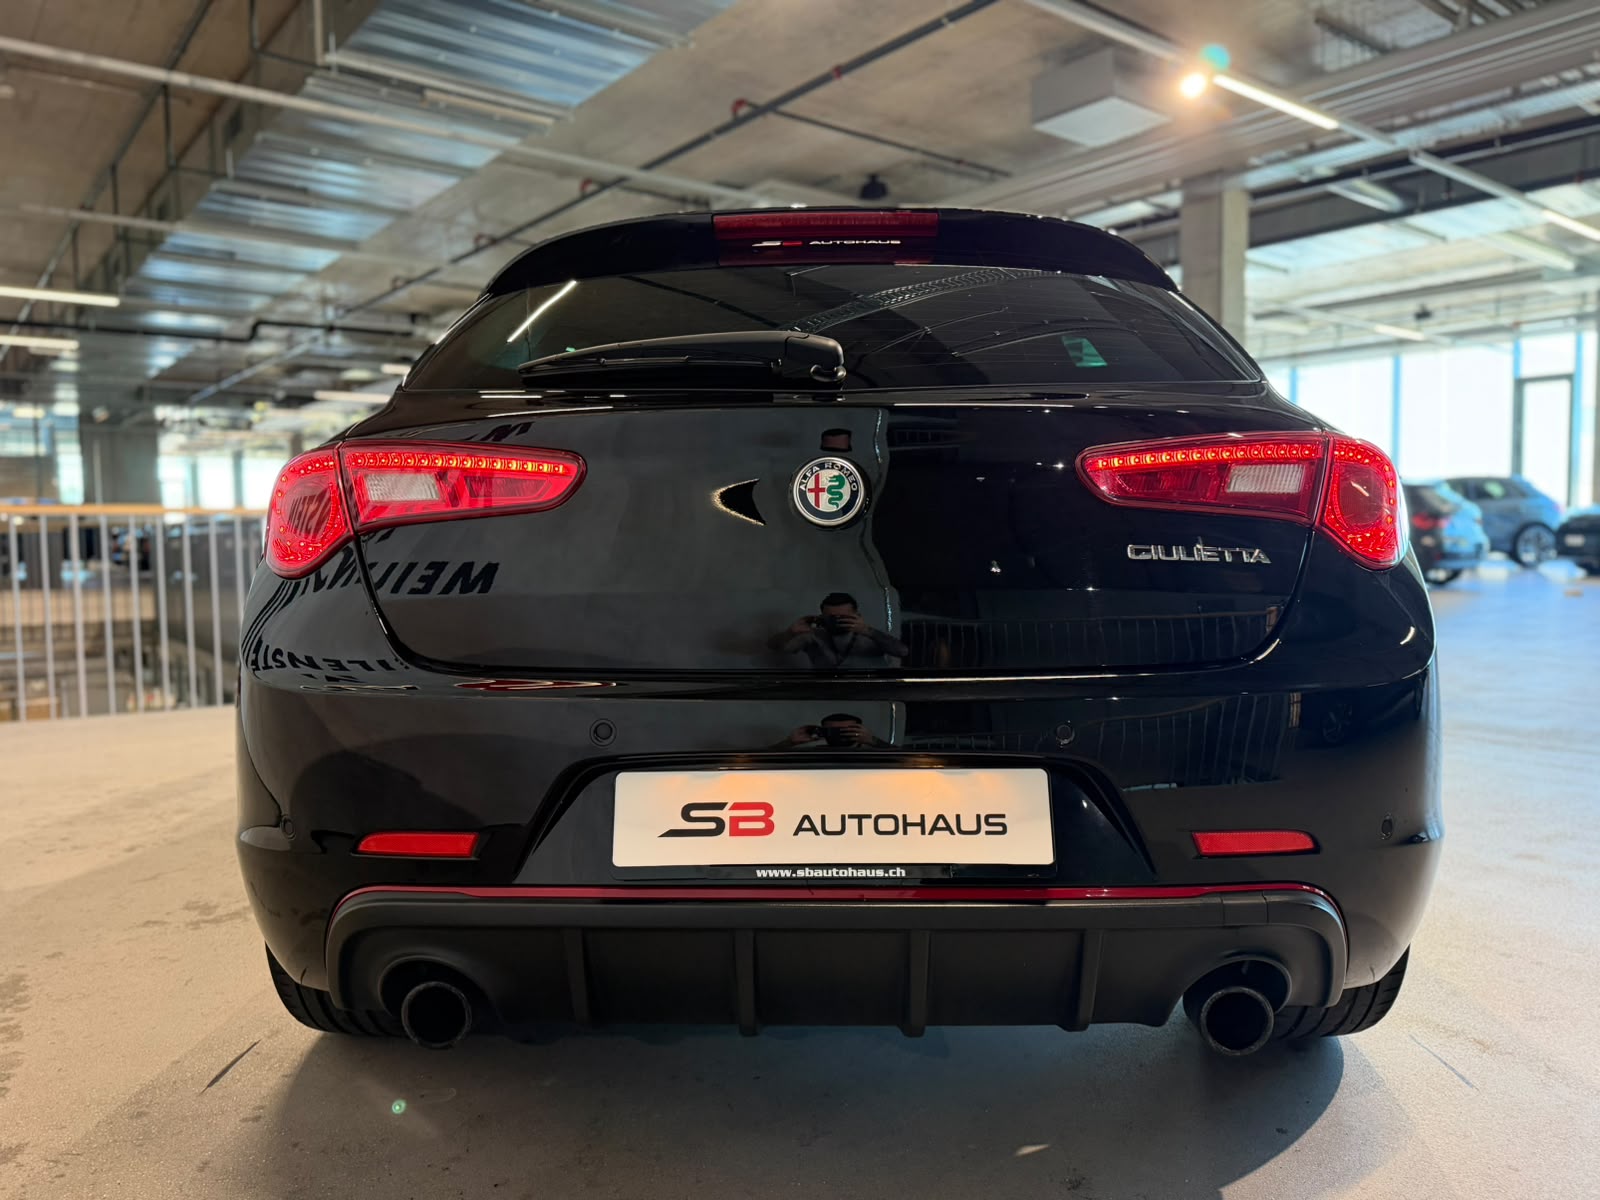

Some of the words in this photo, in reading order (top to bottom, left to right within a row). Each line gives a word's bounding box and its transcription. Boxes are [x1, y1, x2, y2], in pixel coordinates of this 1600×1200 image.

[799, 465, 820, 491] ALFA
[824, 462, 858, 491] ROMEO
[1127, 543, 1272, 564] GIULIETTA
[657, 801, 775, 838] SB
[792, 813, 1008, 837] AUTOHAUS
[755, 867, 906, 878] www.sbautohaus.ch
